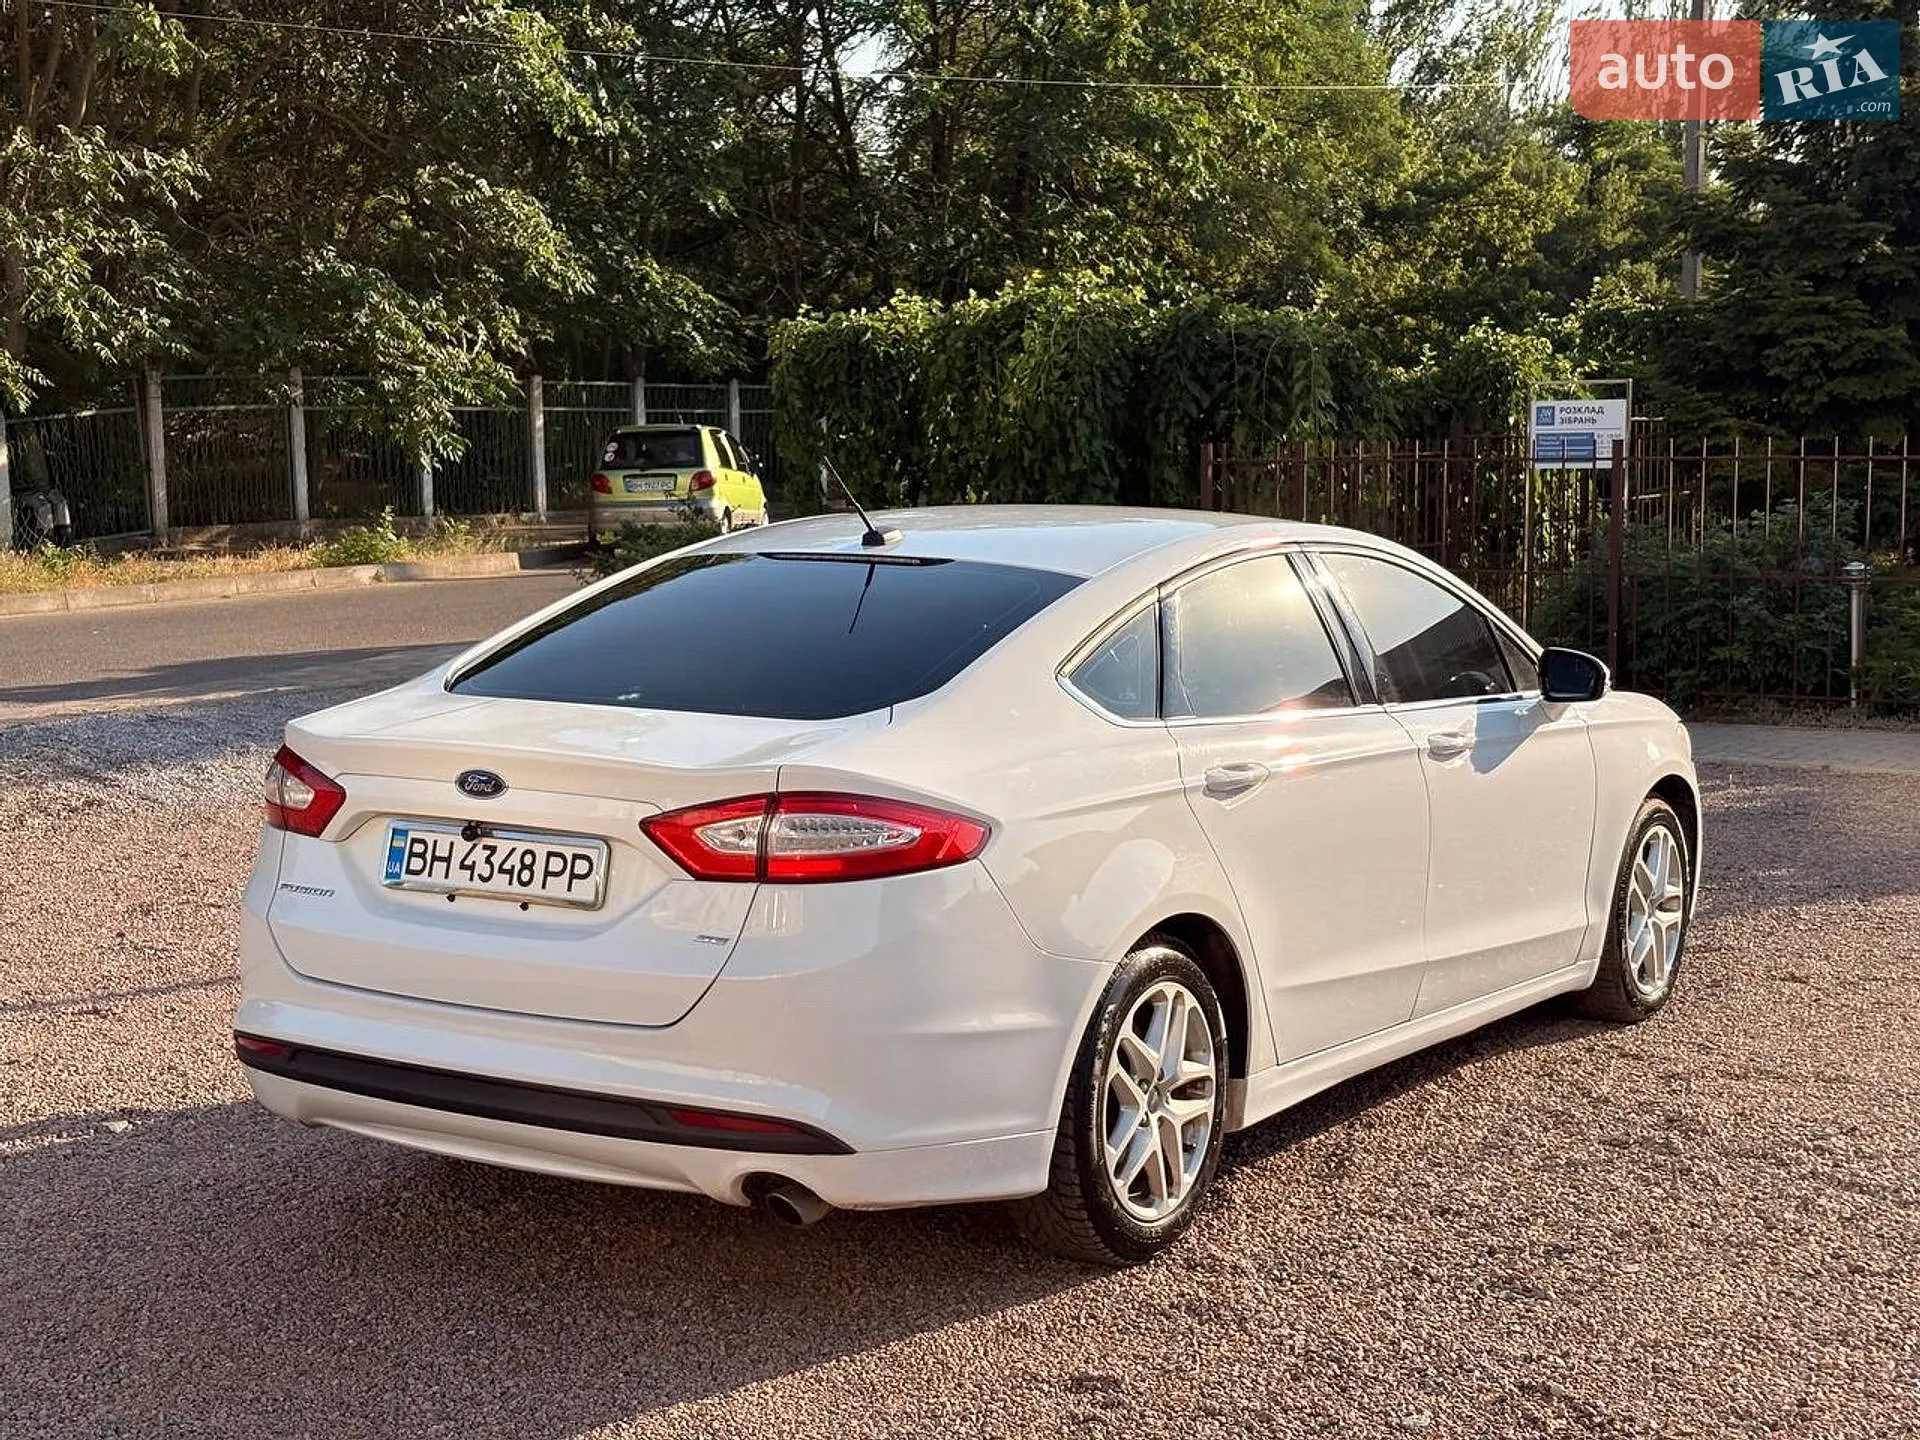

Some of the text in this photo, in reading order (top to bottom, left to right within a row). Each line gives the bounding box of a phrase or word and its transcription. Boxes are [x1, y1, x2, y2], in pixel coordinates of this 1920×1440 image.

[1559, 406, 1605, 415] РОЗКЛАД
[1559, 416, 1597, 425] ЗІБРАНЬ
[464, 771, 496, 792] Ford
[387, 861, 401, 874] UA
[405, 837, 594, 892] BH 4348 PP
